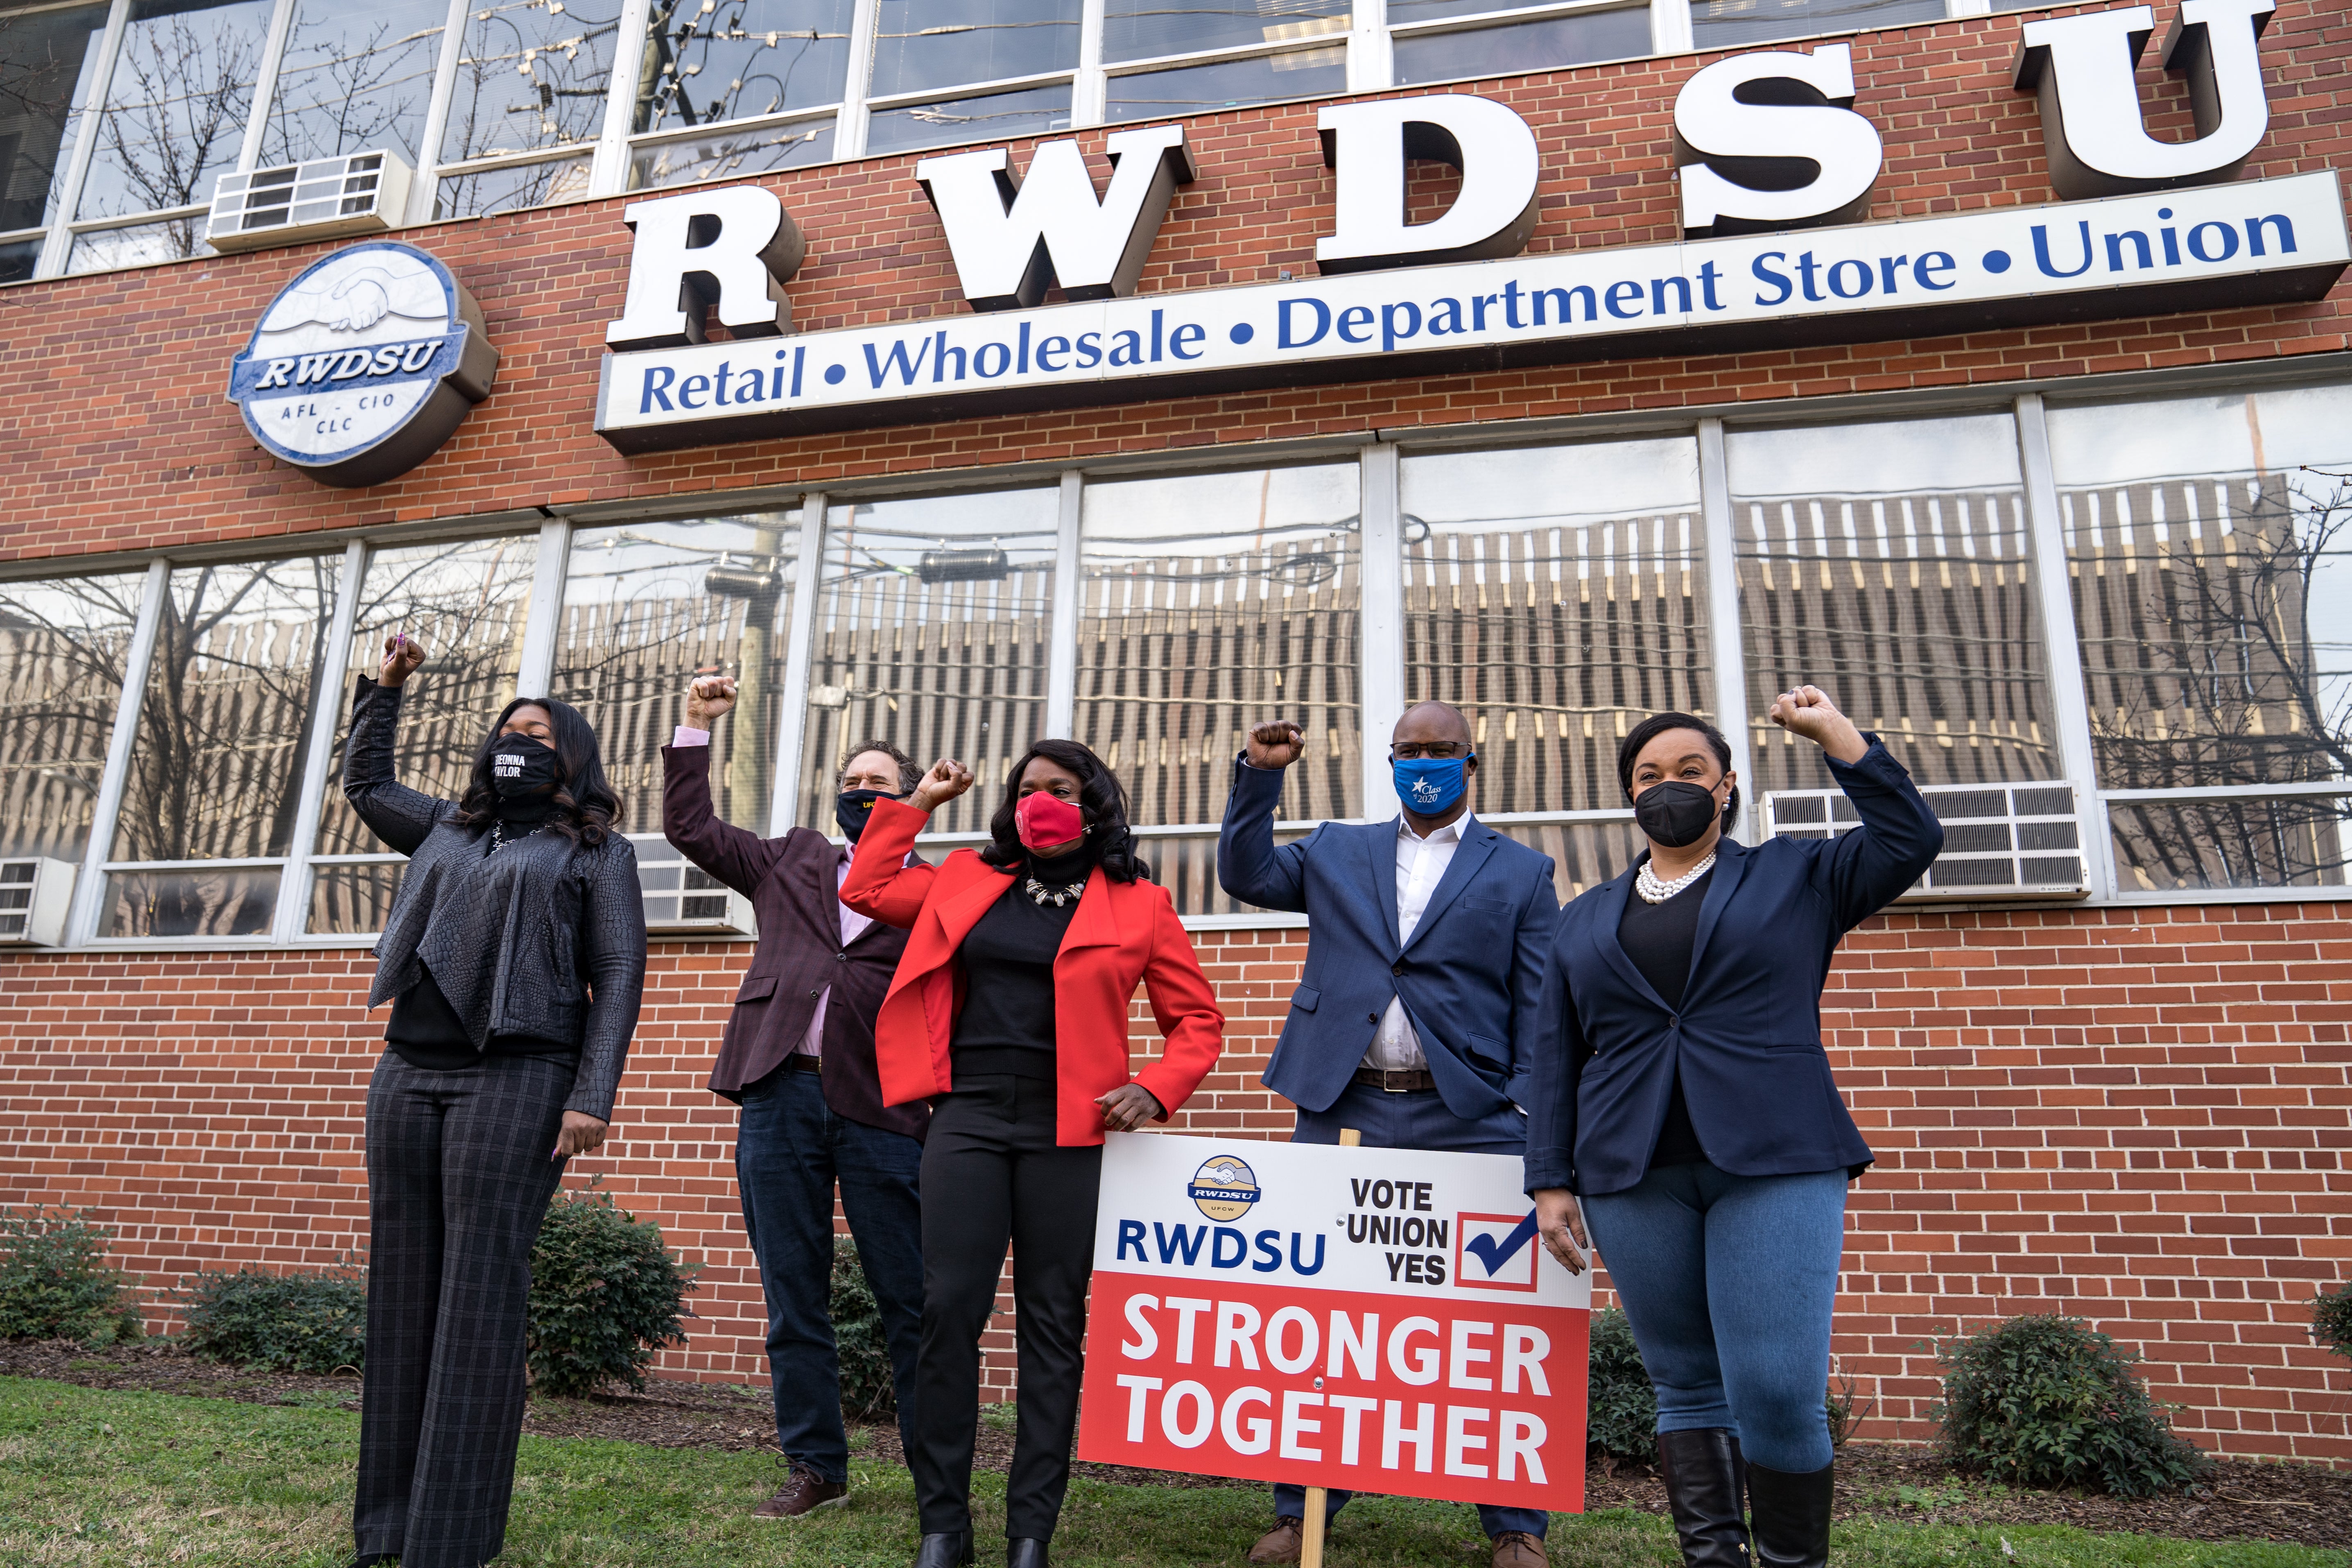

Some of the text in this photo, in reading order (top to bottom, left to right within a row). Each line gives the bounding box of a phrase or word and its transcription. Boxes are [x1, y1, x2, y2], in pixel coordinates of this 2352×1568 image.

[606, 0, 2277, 343] RWDSU
[640, 207, 2298, 414] Retail Wholesale Department Store Union
[255, 340, 443, 389] RWDSU
[281, 403, 317, 419] AFL
[359, 394, 394, 410] CIO
[316, 417, 352, 434] CLC
[1417, 794, 1438, 803] 2020
[1422, 785, 1441, 795] Class
[1194, 1189, 1254, 1199] RWDSU
[1350, 1178, 1433, 1212] VOTE
[1116, 1219, 1326, 1276] RWDSU
[1347, 1213, 1448, 1249] UNION
[1384, 1251, 1446, 1286] YES
[1121, 1293, 1551, 1396] STRONGER
[1116, 1373, 1548, 1484] TOGETHER
